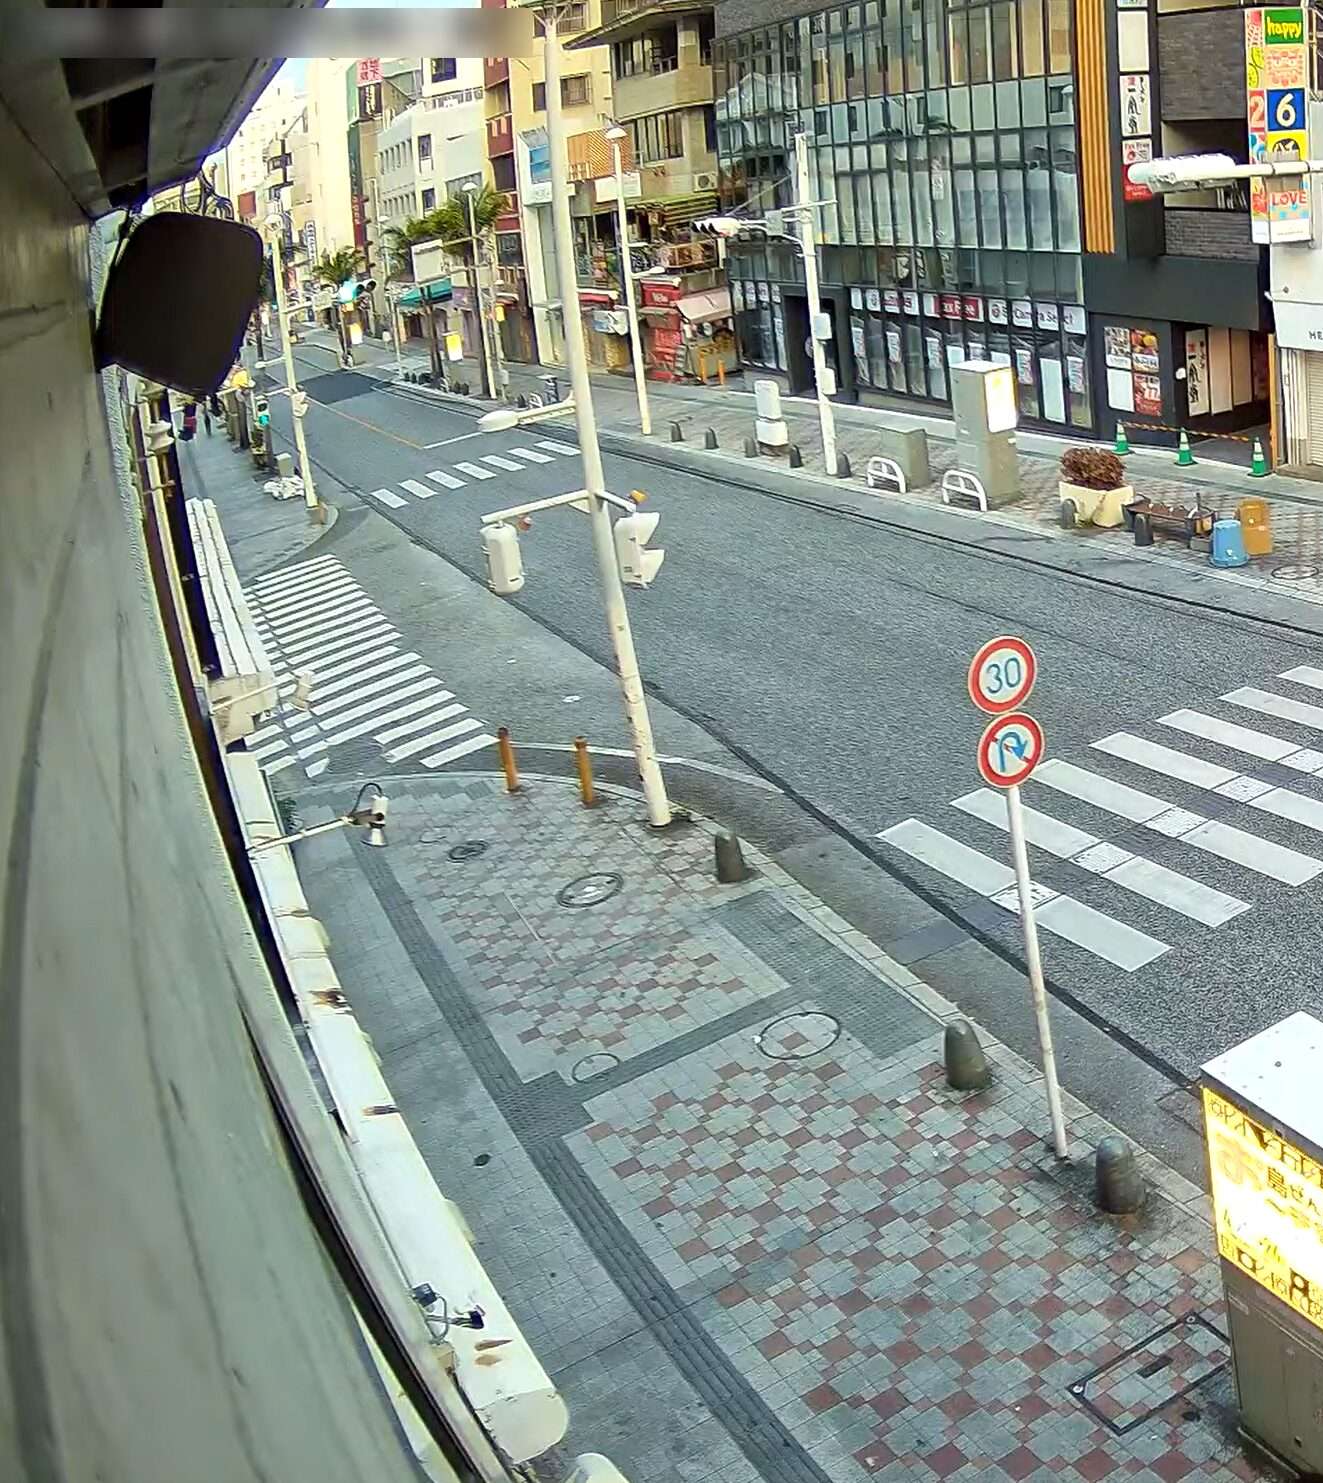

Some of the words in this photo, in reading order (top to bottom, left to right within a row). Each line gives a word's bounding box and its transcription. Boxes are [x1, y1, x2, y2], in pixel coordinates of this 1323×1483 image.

[1266, 16, 1302, 40] happy
[1276, 92, 1297, 128] 6
[1271, 191, 1308, 206] LOVE
[986, 657, 1021, 694] 30
